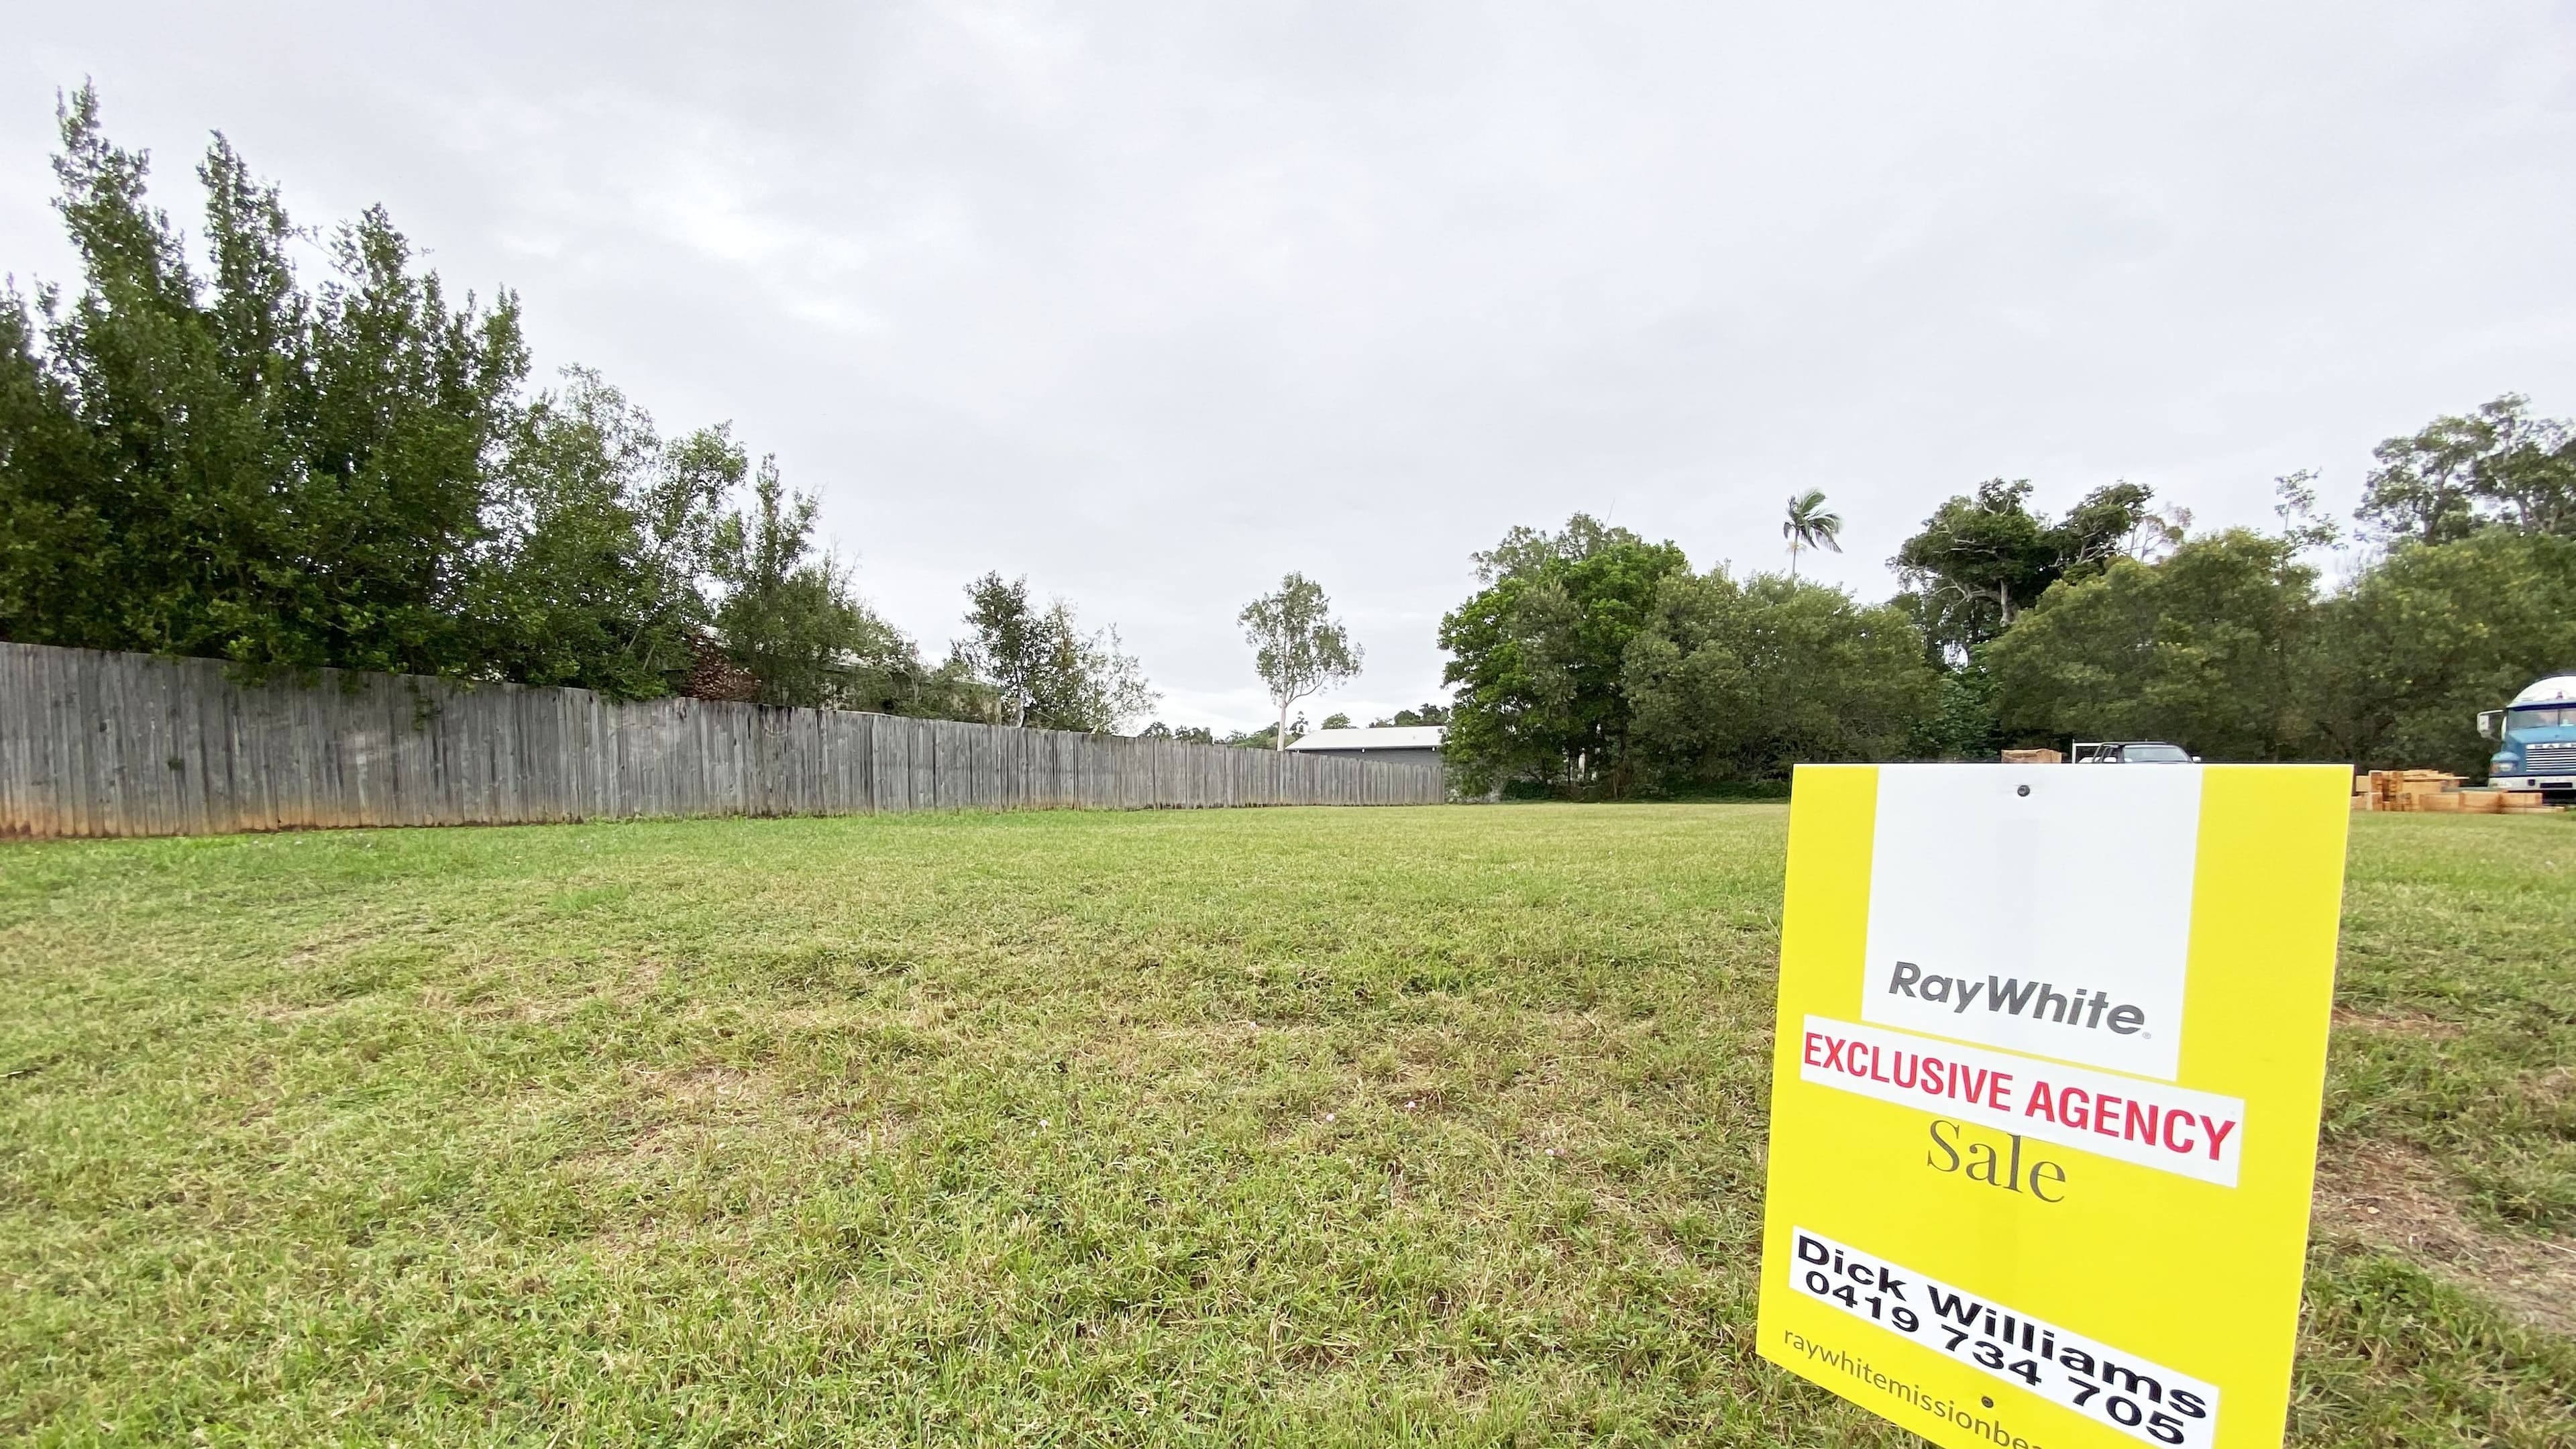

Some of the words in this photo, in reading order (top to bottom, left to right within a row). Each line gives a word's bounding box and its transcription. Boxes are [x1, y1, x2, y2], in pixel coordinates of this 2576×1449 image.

[1888, 961, 2145, 1035] RayWhite
[1804, 1032, 2012, 1112] EXCLUSIVE
[2025, 1080, 2237, 1161] AGENCY
[1927, 1119, 2067, 1203] Sale
[1784, 1328, 2043, 1449] raywhitemissionbe
[1798, 1234, 1907, 1301] Dick
[1927, 1285, 2207, 1419] Williams
[1805, 1271, 1920, 1334] 0419
[1940, 1324, 2042, 1387] 734
[2068, 1376, 2185, 1446] 705
